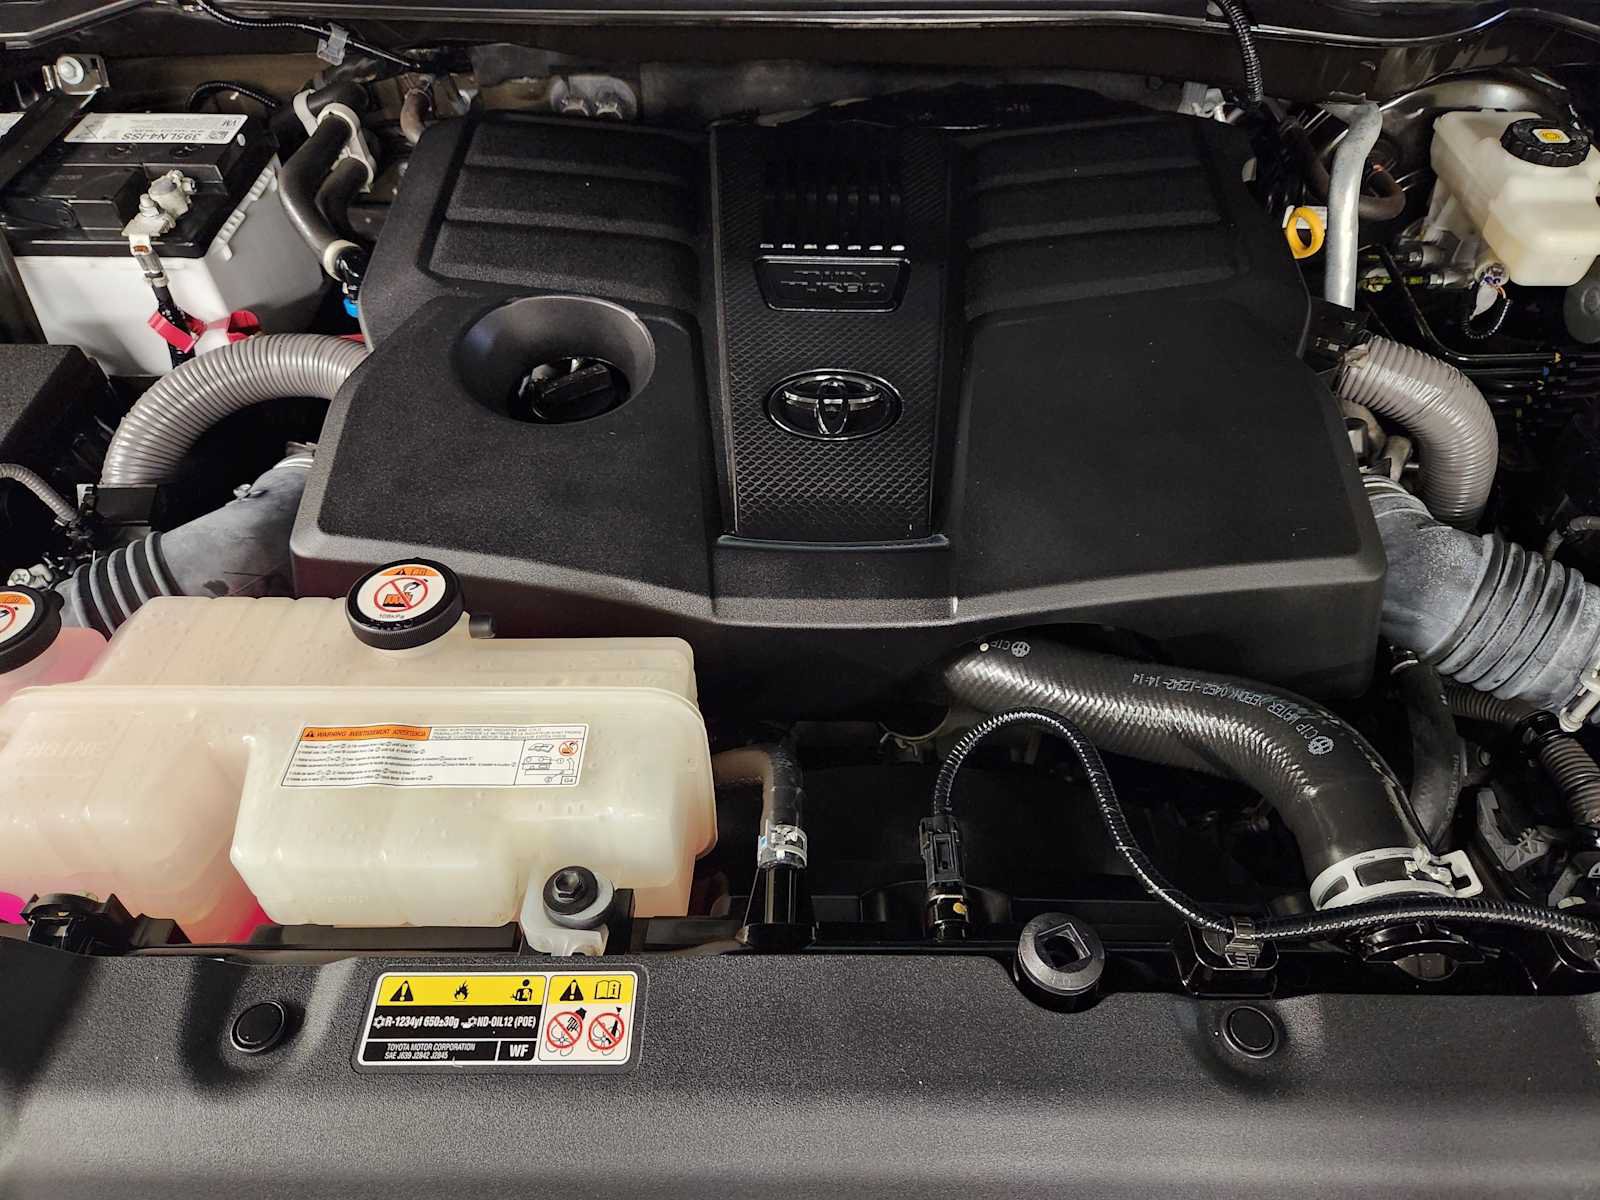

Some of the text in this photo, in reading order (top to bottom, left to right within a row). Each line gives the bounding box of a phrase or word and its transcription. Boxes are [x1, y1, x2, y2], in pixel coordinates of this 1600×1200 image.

[384, 1015, 424, 1029] R-1234yf
[423, 1015, 460, 1029] 650±30g
[514, 1015, 537, 1030] (POE)
[387, 1042, 476, 1052] TOYOTA MOTOR CORPORATION
[509, 1043, 530, 1058] WF
[384, 1051, 399, 1060] SAE
[397, 1051, 413, 1060] J639
